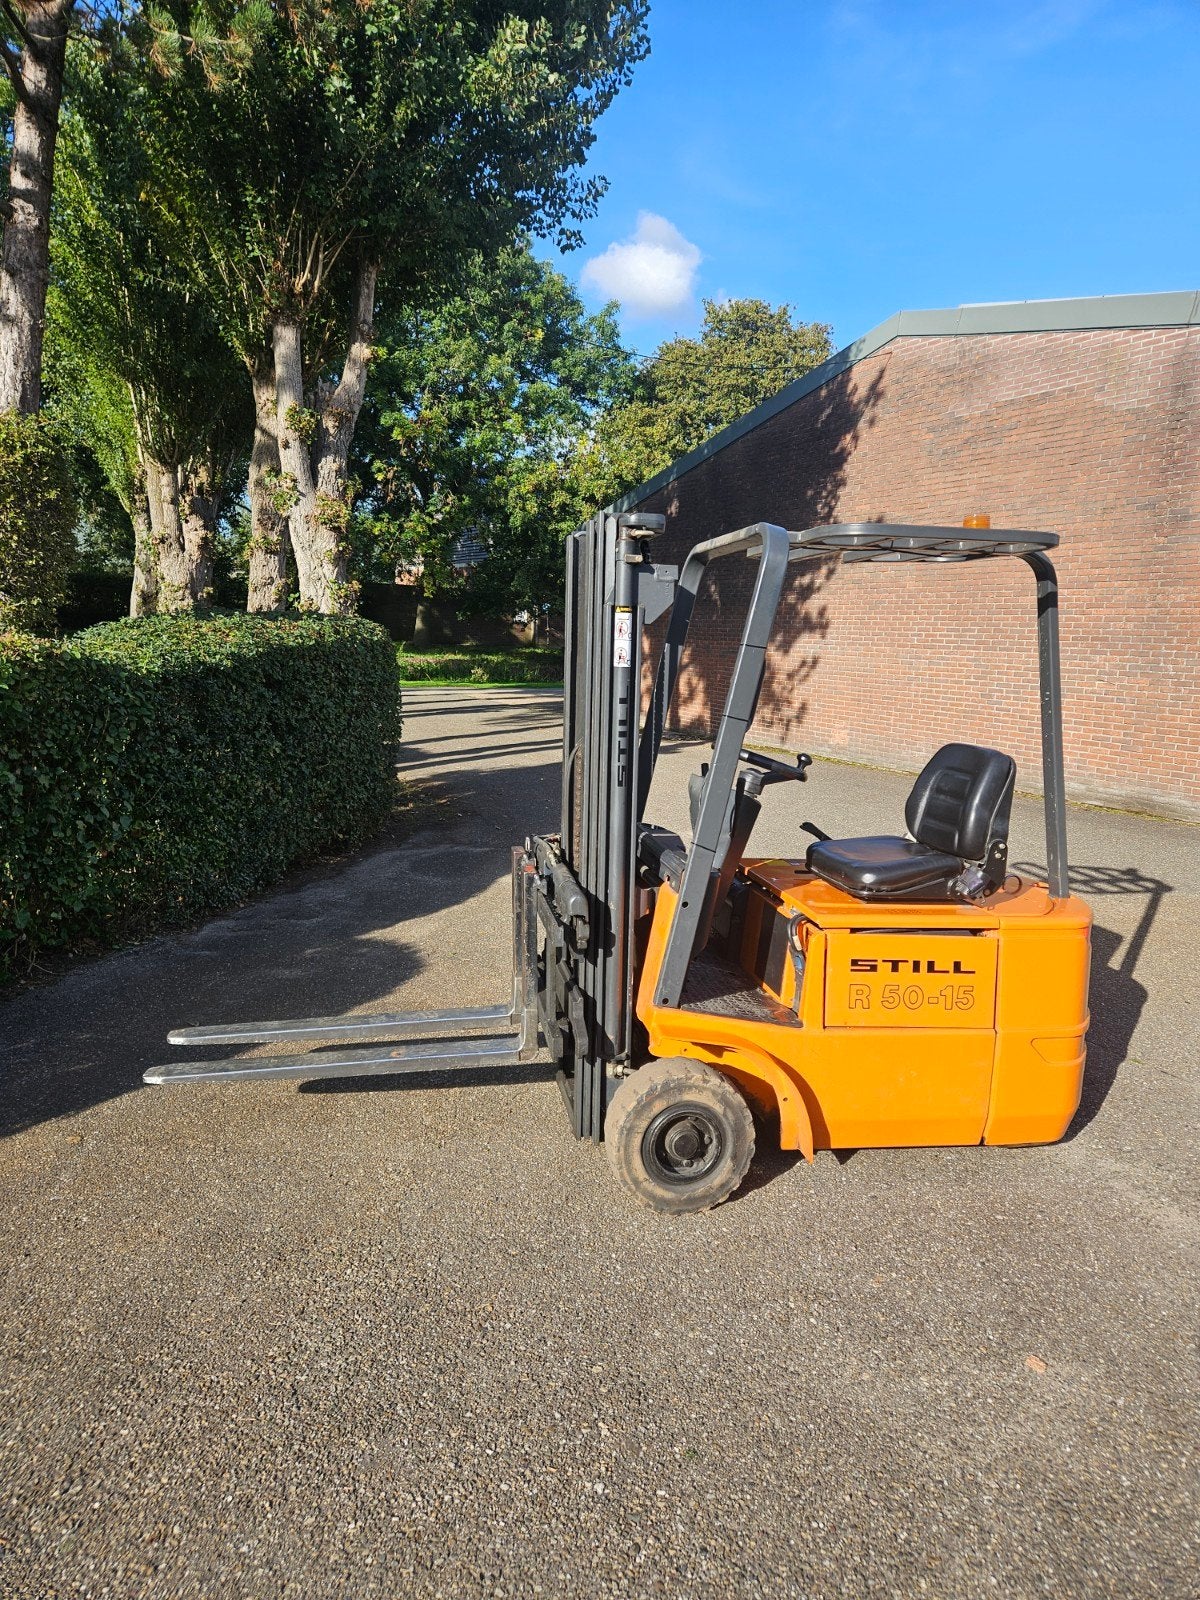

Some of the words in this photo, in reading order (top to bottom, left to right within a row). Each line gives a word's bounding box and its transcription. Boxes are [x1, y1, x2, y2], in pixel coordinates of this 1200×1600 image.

[618, 685, 628, 787] STILL
[850, 959, 975, 974] STILL
[849, 984, 871, 1009] R
[881, 985, 975, 1010] 50-15
